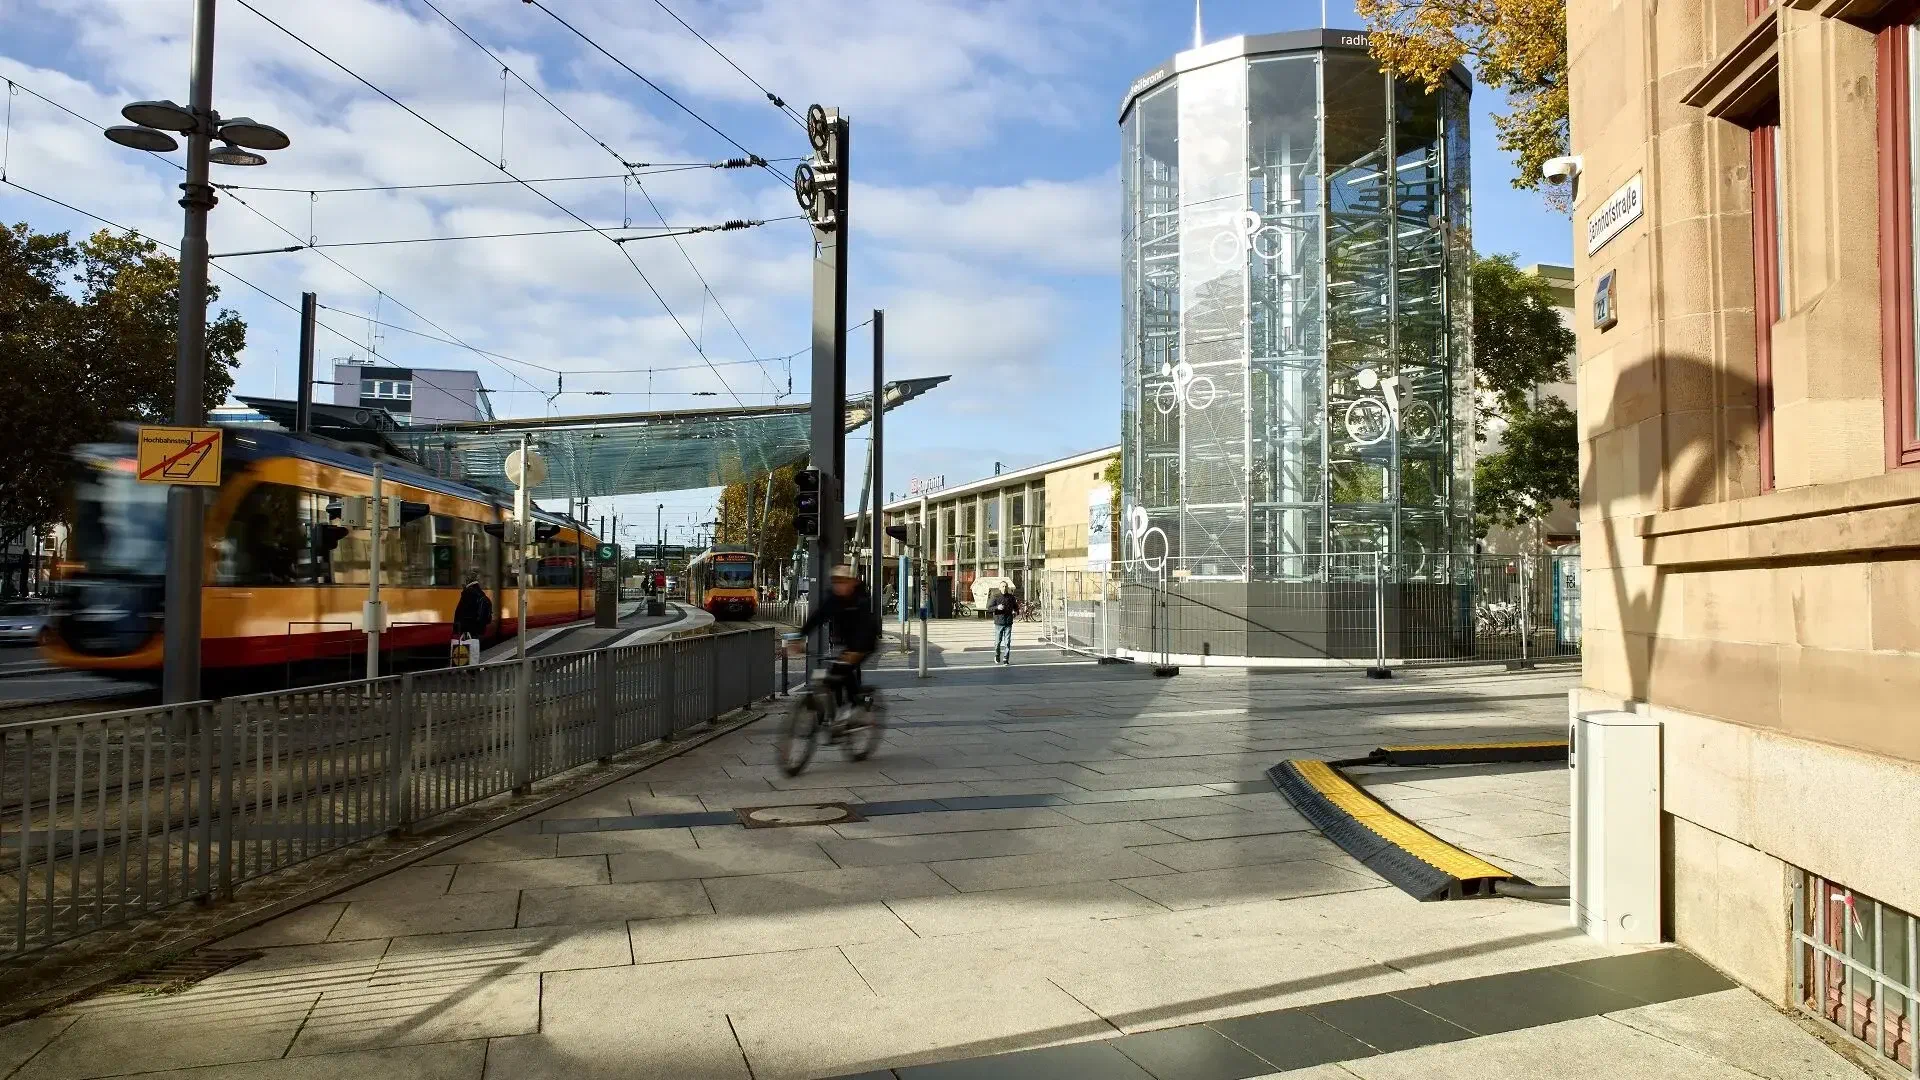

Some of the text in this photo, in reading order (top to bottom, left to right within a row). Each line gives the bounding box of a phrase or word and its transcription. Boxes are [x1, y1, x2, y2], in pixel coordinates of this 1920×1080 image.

[1589, 187, 1637, 243] Bahnhofstraße
[143, 437, 191, 446] Hochbahnsteig
[602, 546, 612, 558] S
